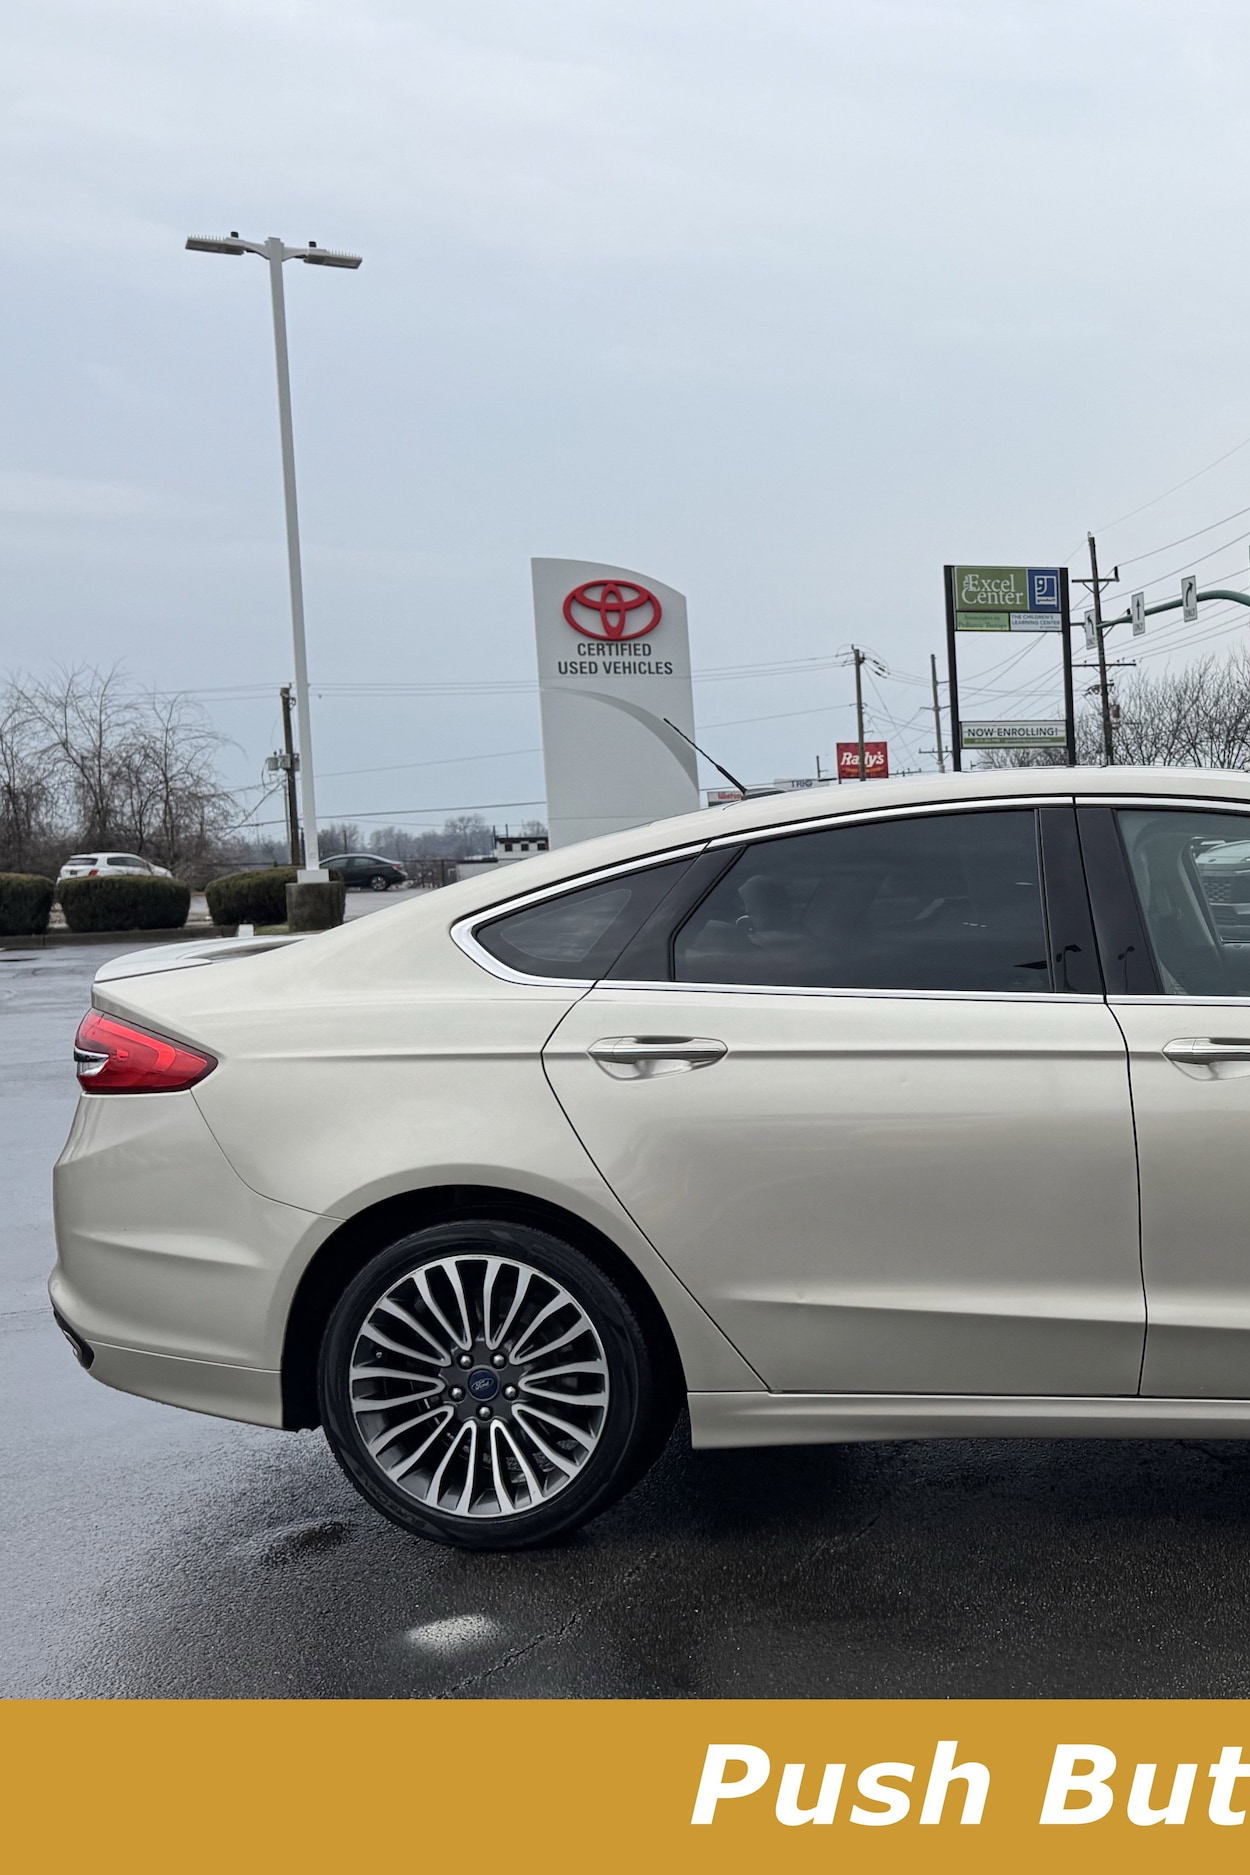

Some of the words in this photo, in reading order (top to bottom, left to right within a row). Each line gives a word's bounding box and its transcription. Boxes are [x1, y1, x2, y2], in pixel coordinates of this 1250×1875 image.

[968, 574, 1016, 592] Excel
[961, 587, 1024, 604] Center
[577, 643, 652, 656] CERTIFIED
[558, 661, 598, 675] USED
[603, 661, 673, 675] VEHICLES
[968, 728, 994, 737] NOW
[997, 727, 1058, 737] ENROLLING!
[841, 751, 885, 767] Raly's
